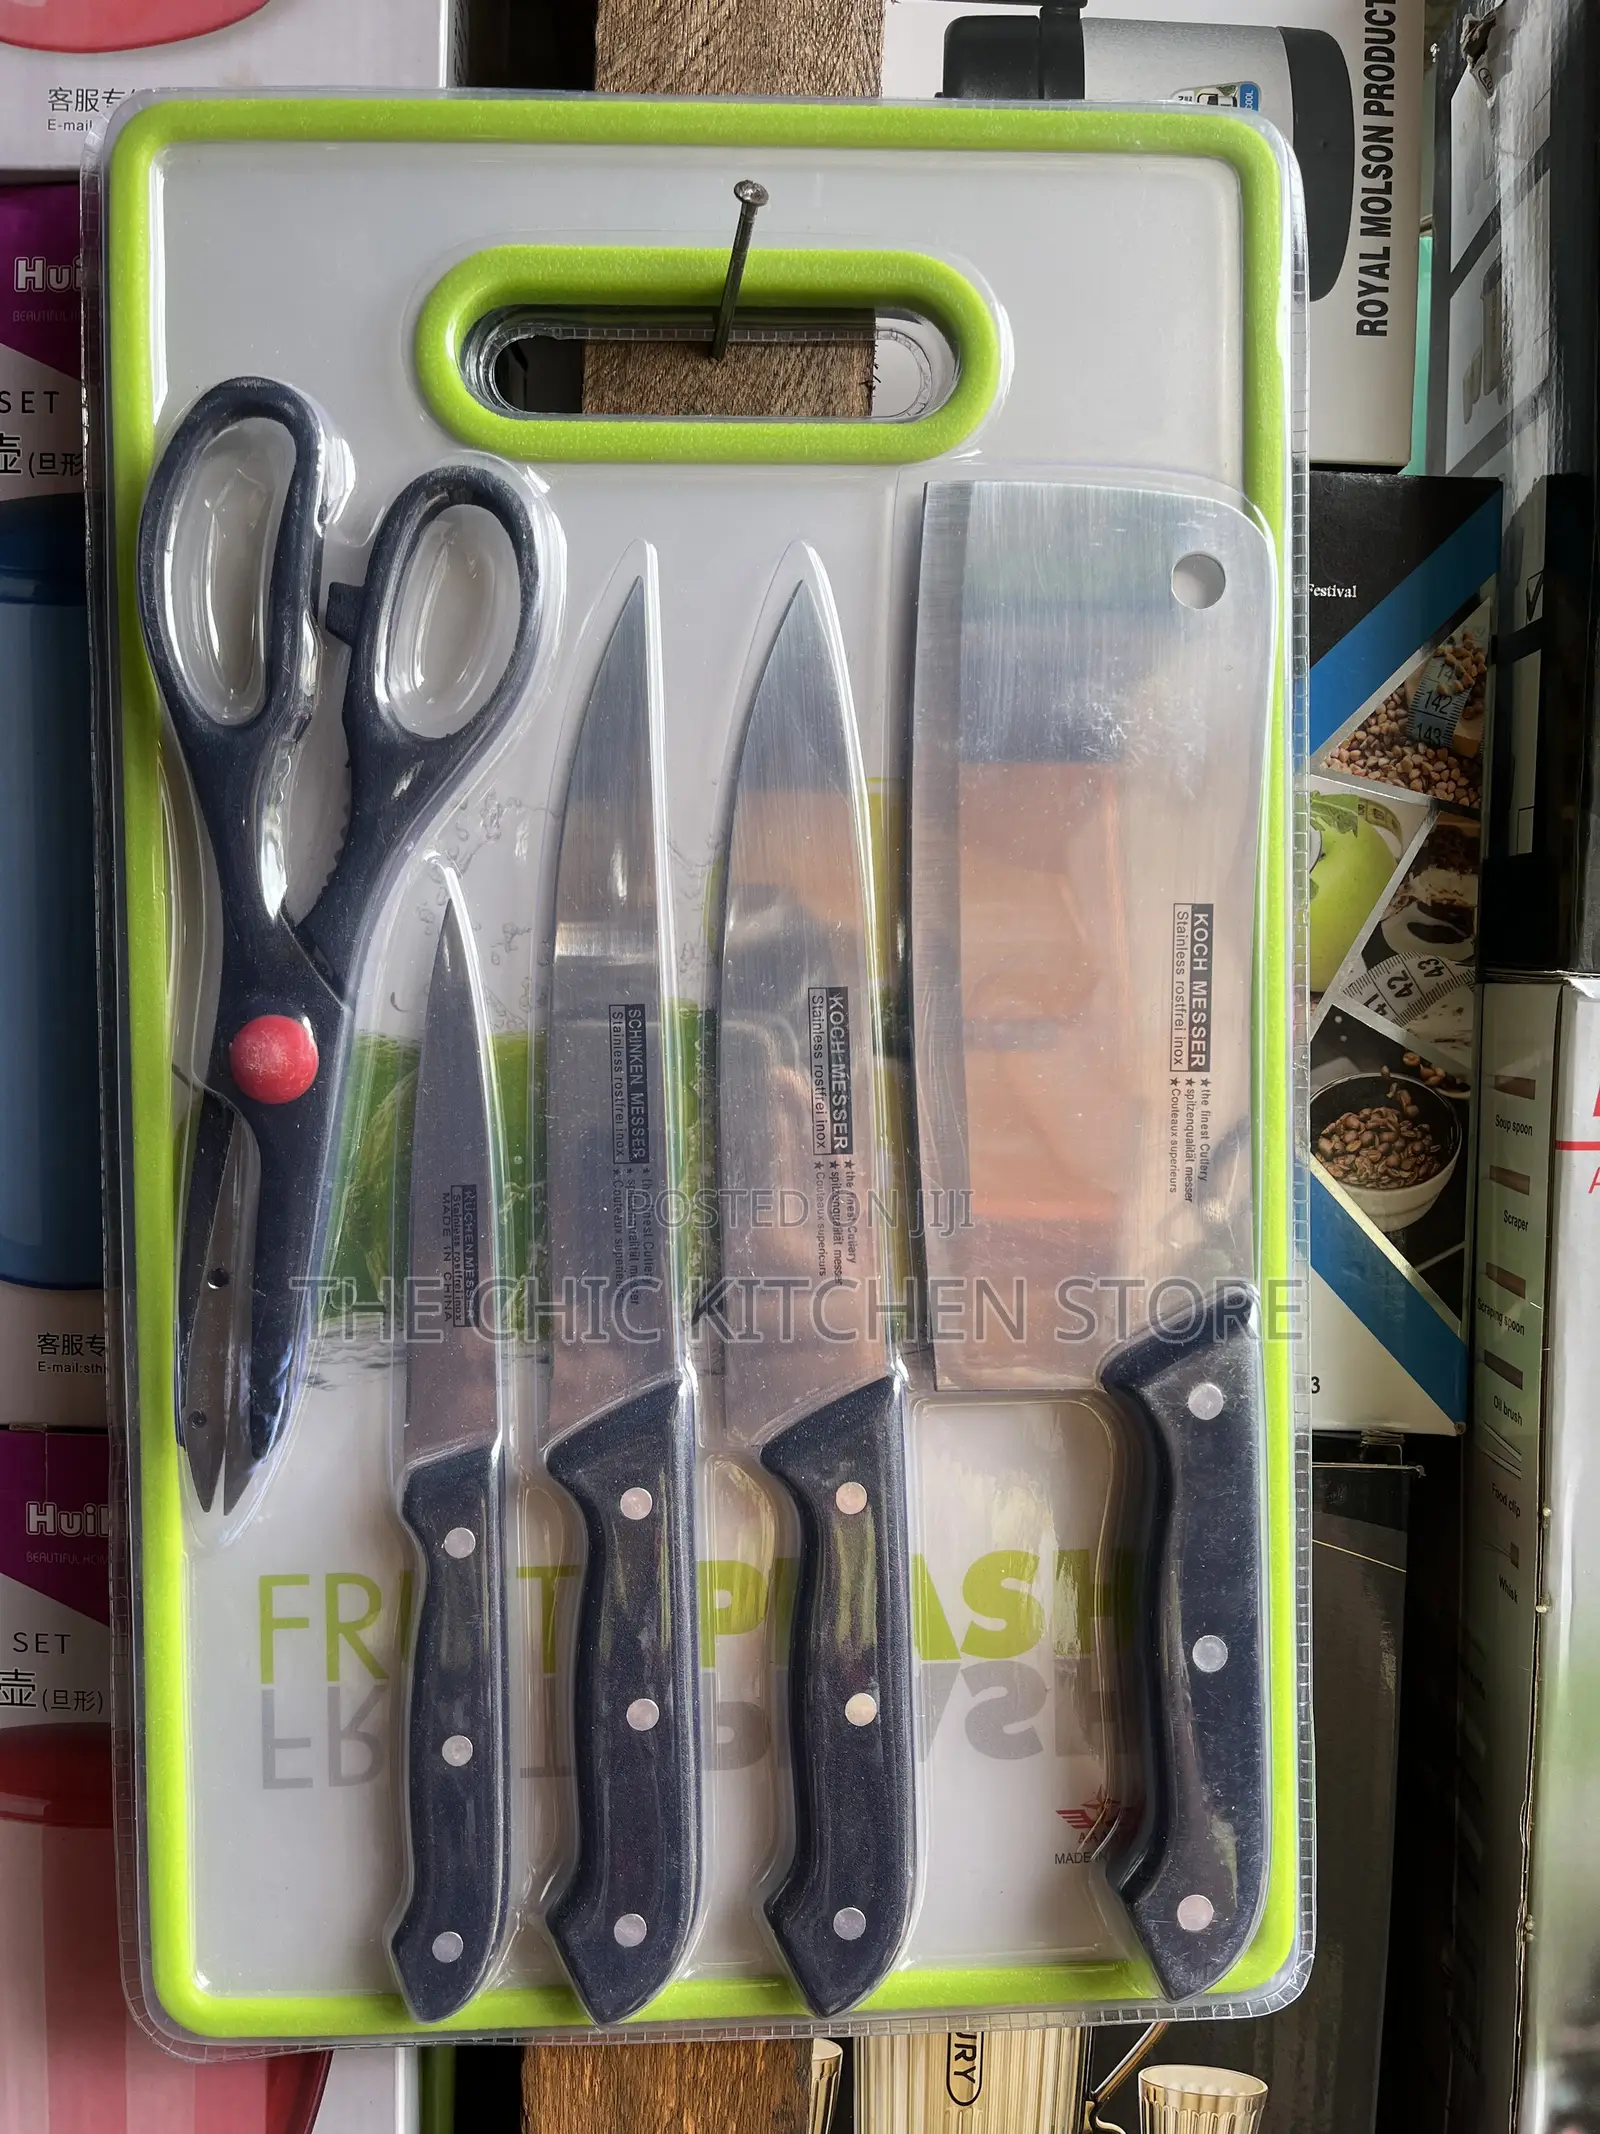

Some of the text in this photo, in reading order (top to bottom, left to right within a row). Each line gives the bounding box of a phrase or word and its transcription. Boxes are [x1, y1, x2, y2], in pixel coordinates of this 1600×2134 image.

[48, 87, 135, 113] 客服专
[1359, 125, 1394, 237] MOLSON
[1356, 246, 1390, 336] ROYAL
[1424, 690, 1453, 715] 142
[1173, 911, 1189, 1066] Stainless rostfrei inox
[1190, 912, 1209, 1069] KOCH MESSER
[612, 1010, 624, 1074] Stainless
[628, 1008, 646, 1162] SCHINKEN MESSER
[812, 995, 828, 1149] Stainless rostfrei inox
[829, 996, 848, 1150] KOCH MESSER
[1170, 1088, 1181, 1137] Couteaux
[1495, 1114, 1533, 1137] Soup spoon
[614, 1126, 625, 1157] inox
[1198, 1089, 1211, 1182] the finest Cutlery
[845, 1171, 855, 1188] the
[1184, 1166, 1194, 1203] messer
[1503, 1209, 1529, 1232] Scraper
[442, 1192, 452, 1323] MADE IN CHINA
[1477, 1297, 1525, 1336] Scraping spoon
[1503, 1401, 1523, 1426] brush
[1491, 1482, 1521, 1519] Food clip
[26, 1551, 80, 1565] BEAUTIFUL
[1498, 1573, 1518, 1605] Whisk
[13, 1632, 72, 1654] SET
[1054, 1852, 1092, 1865] MADE
